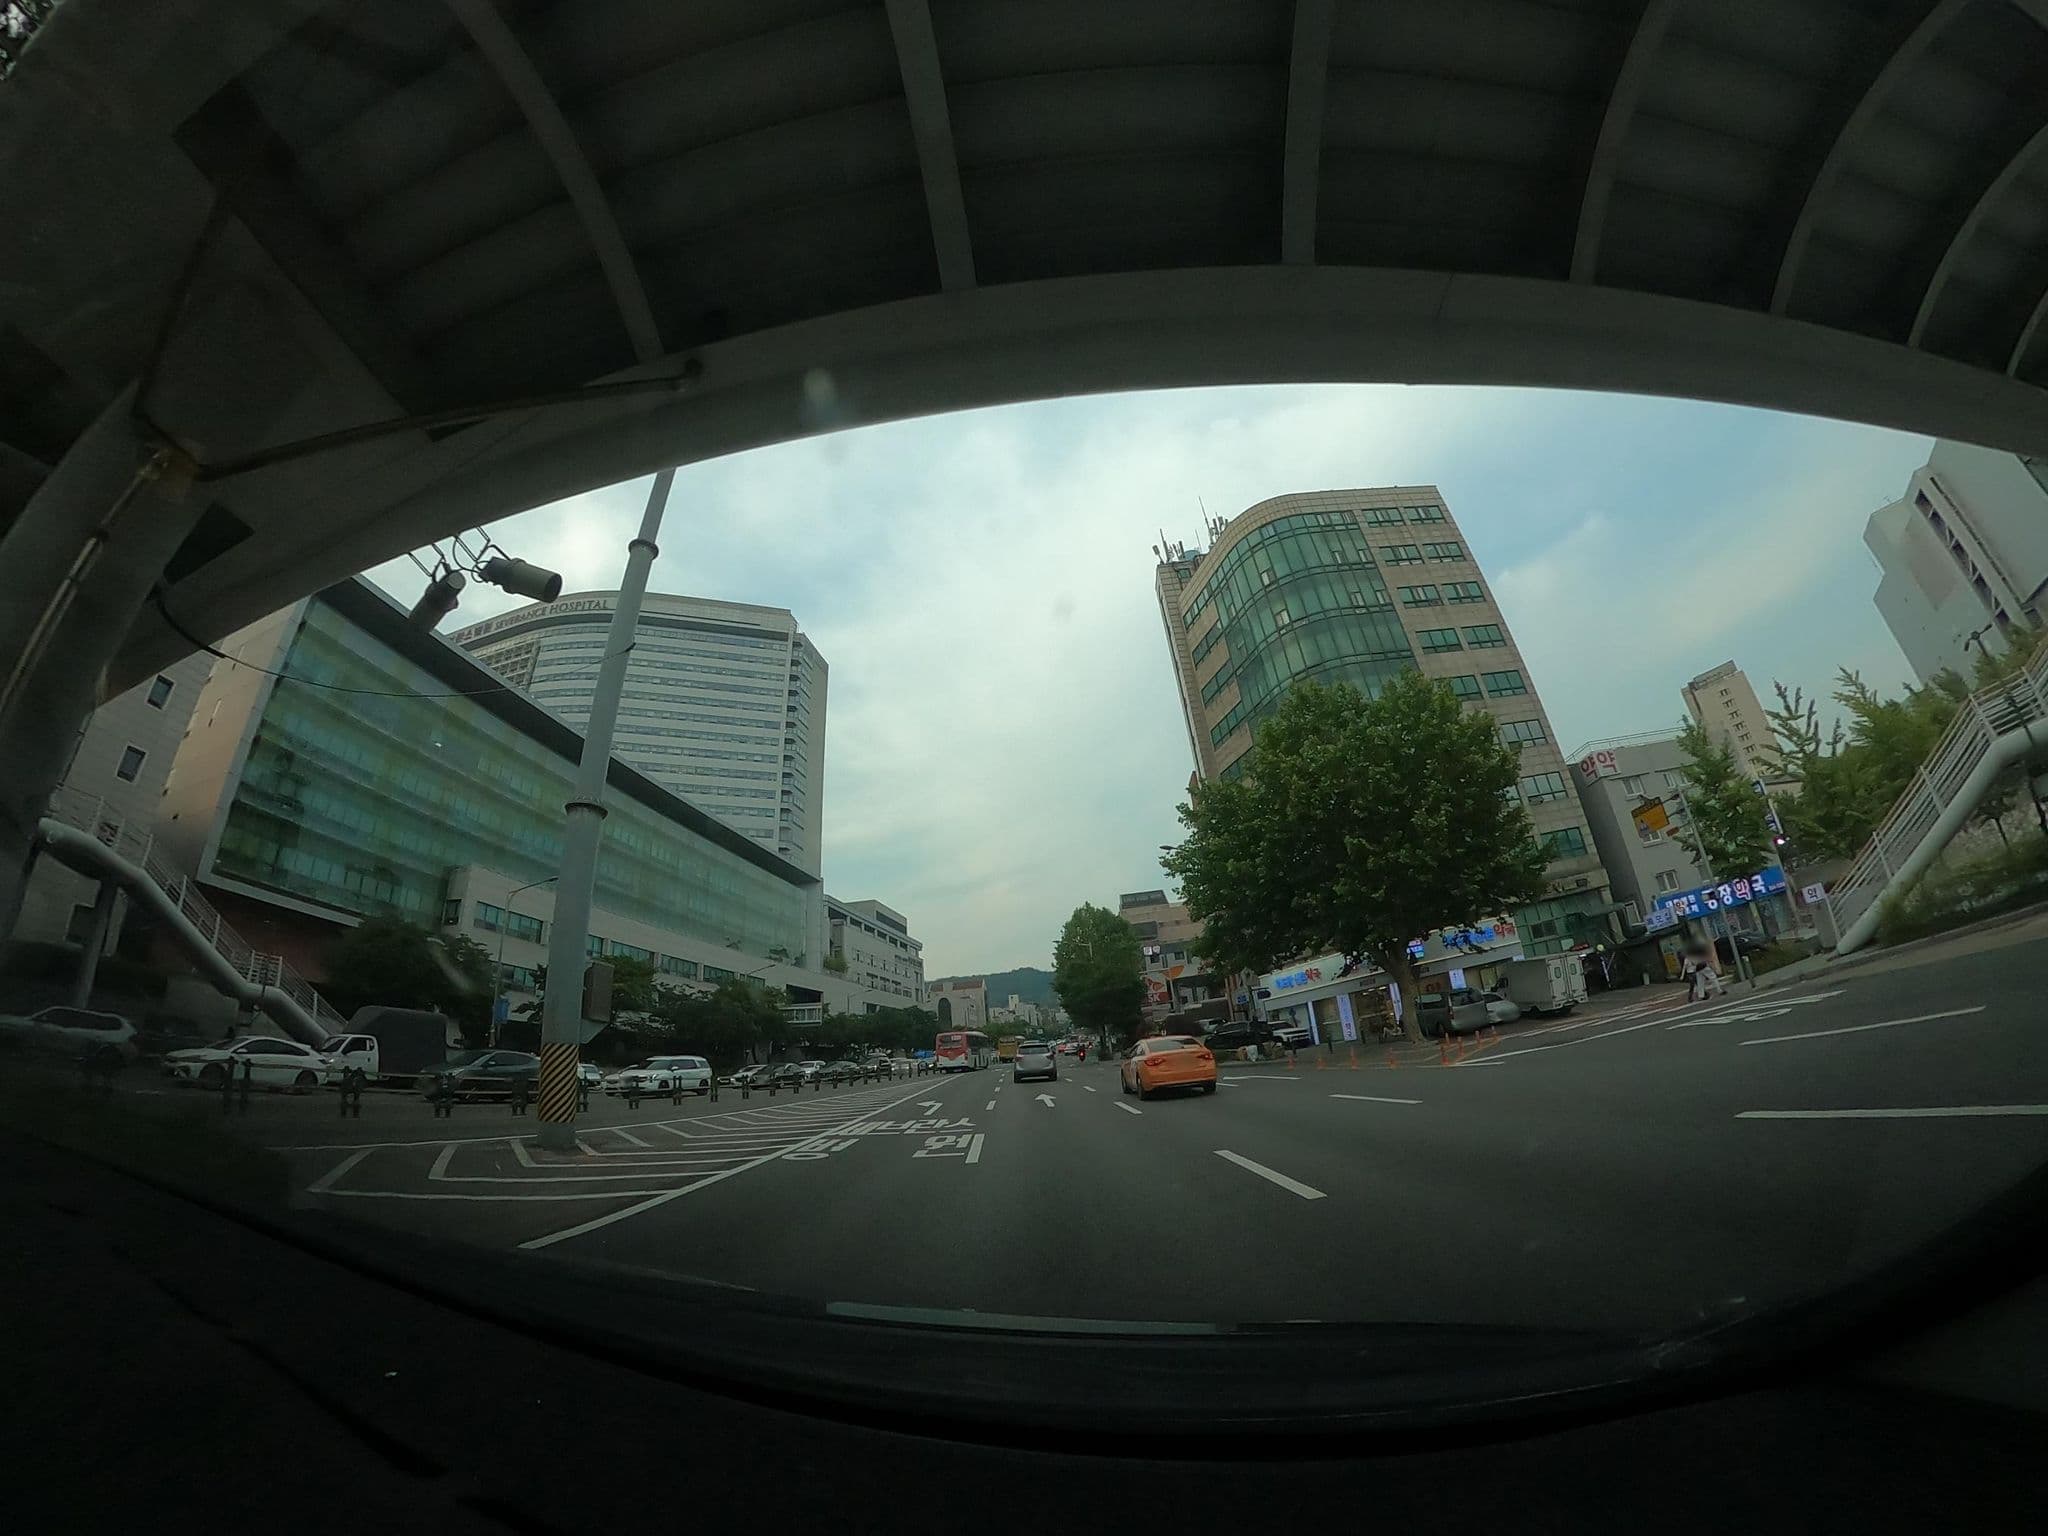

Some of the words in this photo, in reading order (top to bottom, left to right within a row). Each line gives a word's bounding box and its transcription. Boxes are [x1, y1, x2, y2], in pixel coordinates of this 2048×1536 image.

[495, 606, 547, 630] SEVERANCE
[549, 600, 609, 614] HOSPITAL
[1581, 756, 1598, 778] 약
[1597, 750, 1617, 772] 약
